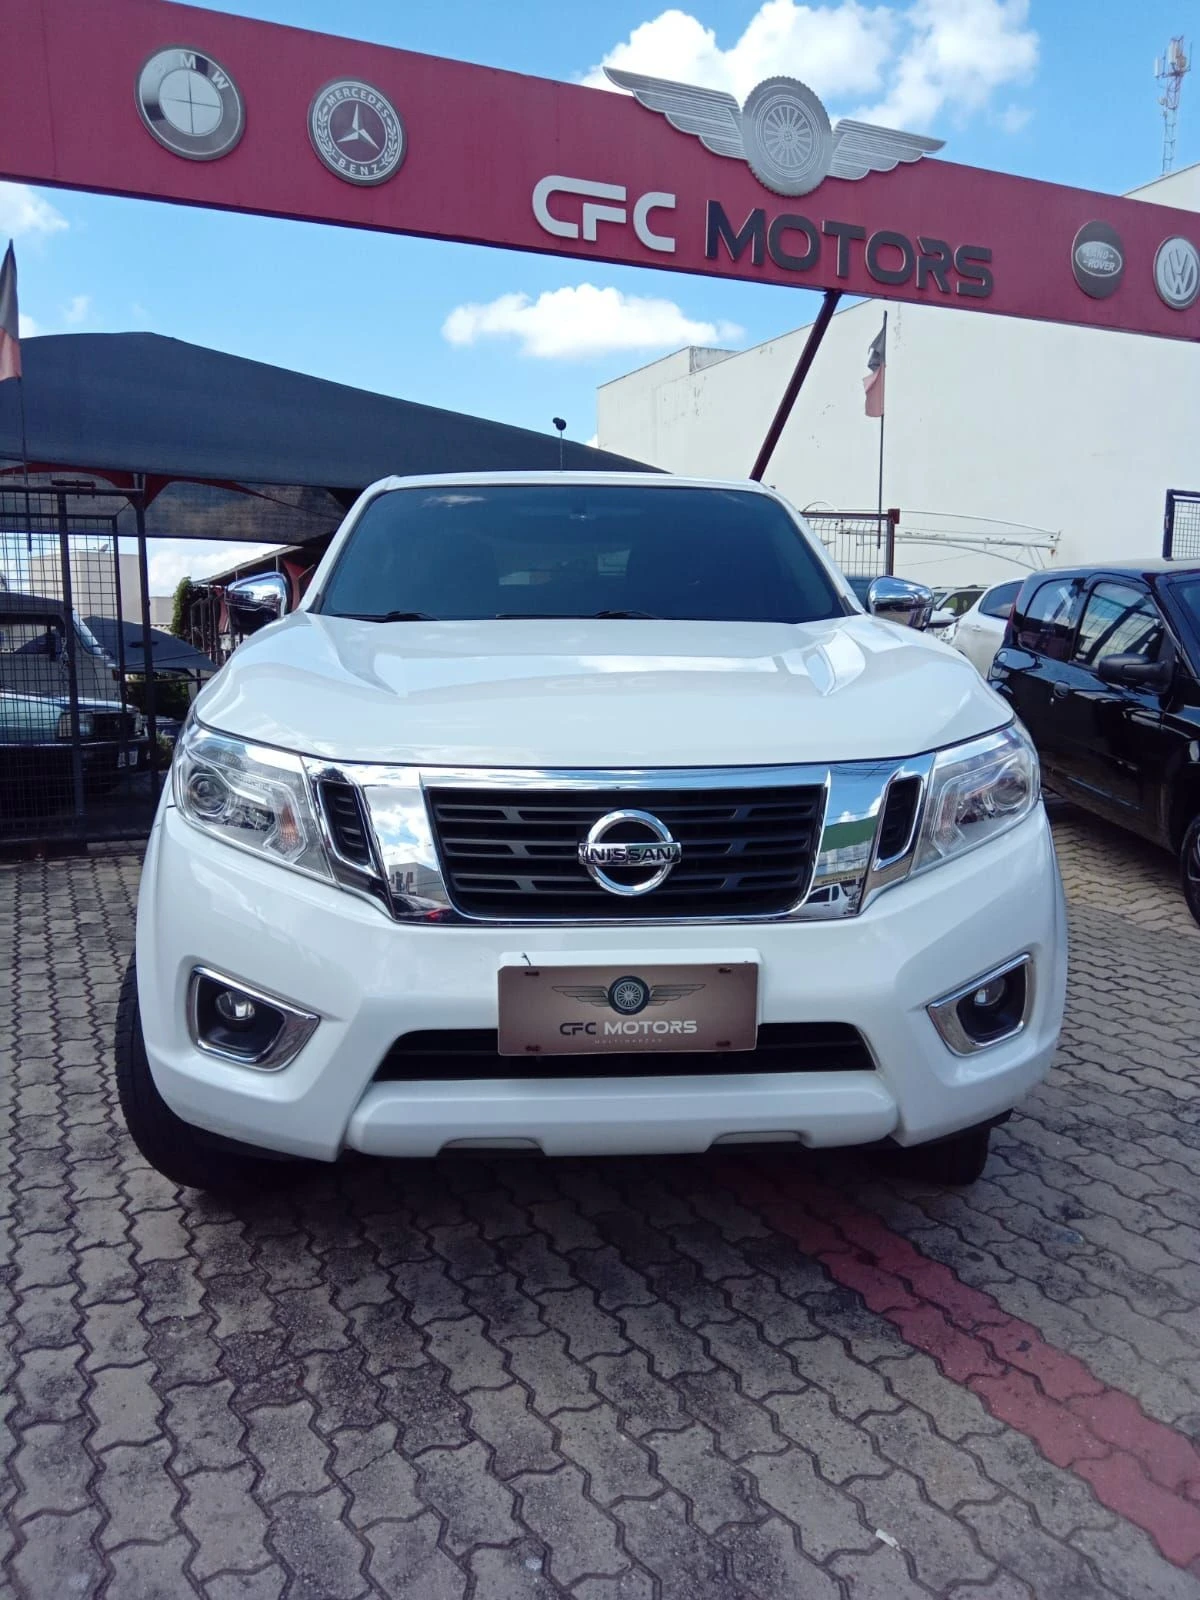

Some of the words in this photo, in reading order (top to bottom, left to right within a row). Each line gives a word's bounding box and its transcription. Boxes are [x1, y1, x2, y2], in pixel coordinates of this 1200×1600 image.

[326, 87, 390, 118] MERCEDES
[337, 158, 380, 176] BENZ
[532, 175, 676, 253] CFC
[705, 200, 993, 297] MOTORS
[1087, 259, 1116, 272] ROVER
[589, 847, 672, 862] NISSAN
[560, 1022, 597, 1036] CFC
[604, 1020, 697, 1036] MOTORS
